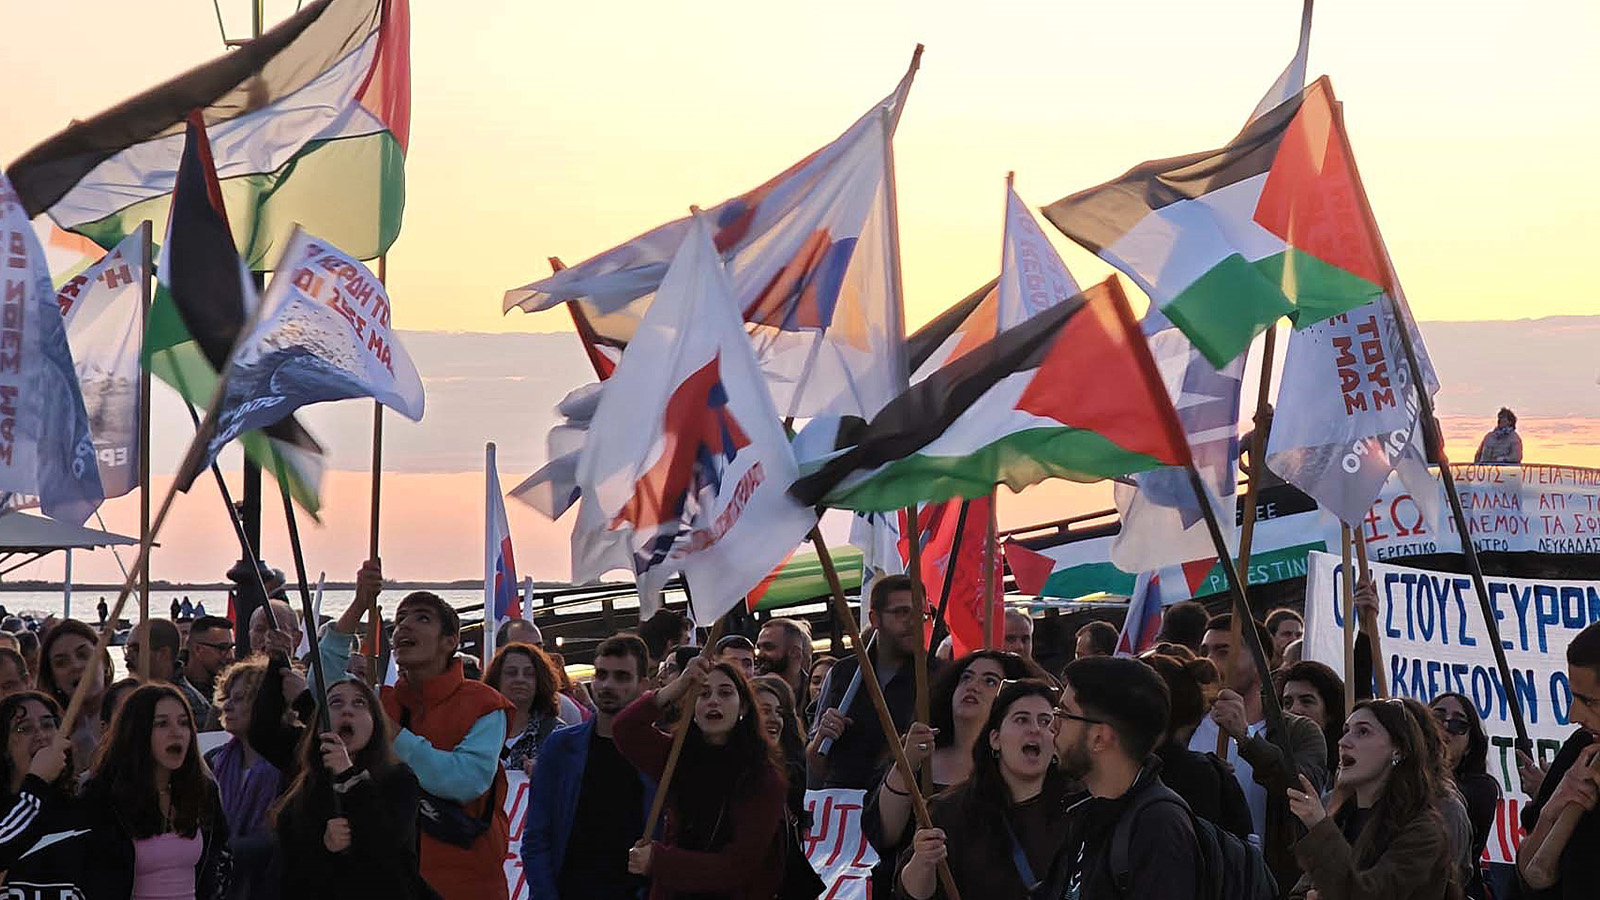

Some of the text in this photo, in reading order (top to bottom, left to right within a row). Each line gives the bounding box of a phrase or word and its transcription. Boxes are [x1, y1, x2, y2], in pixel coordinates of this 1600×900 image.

[1540, 516, 1565, 535] ΤΑ
[1377, 542, 1437, 560] ΕΡΓΑΤΙΚΟ
[1385, 573, 1477, 646] ΣΤΟΥΣ
